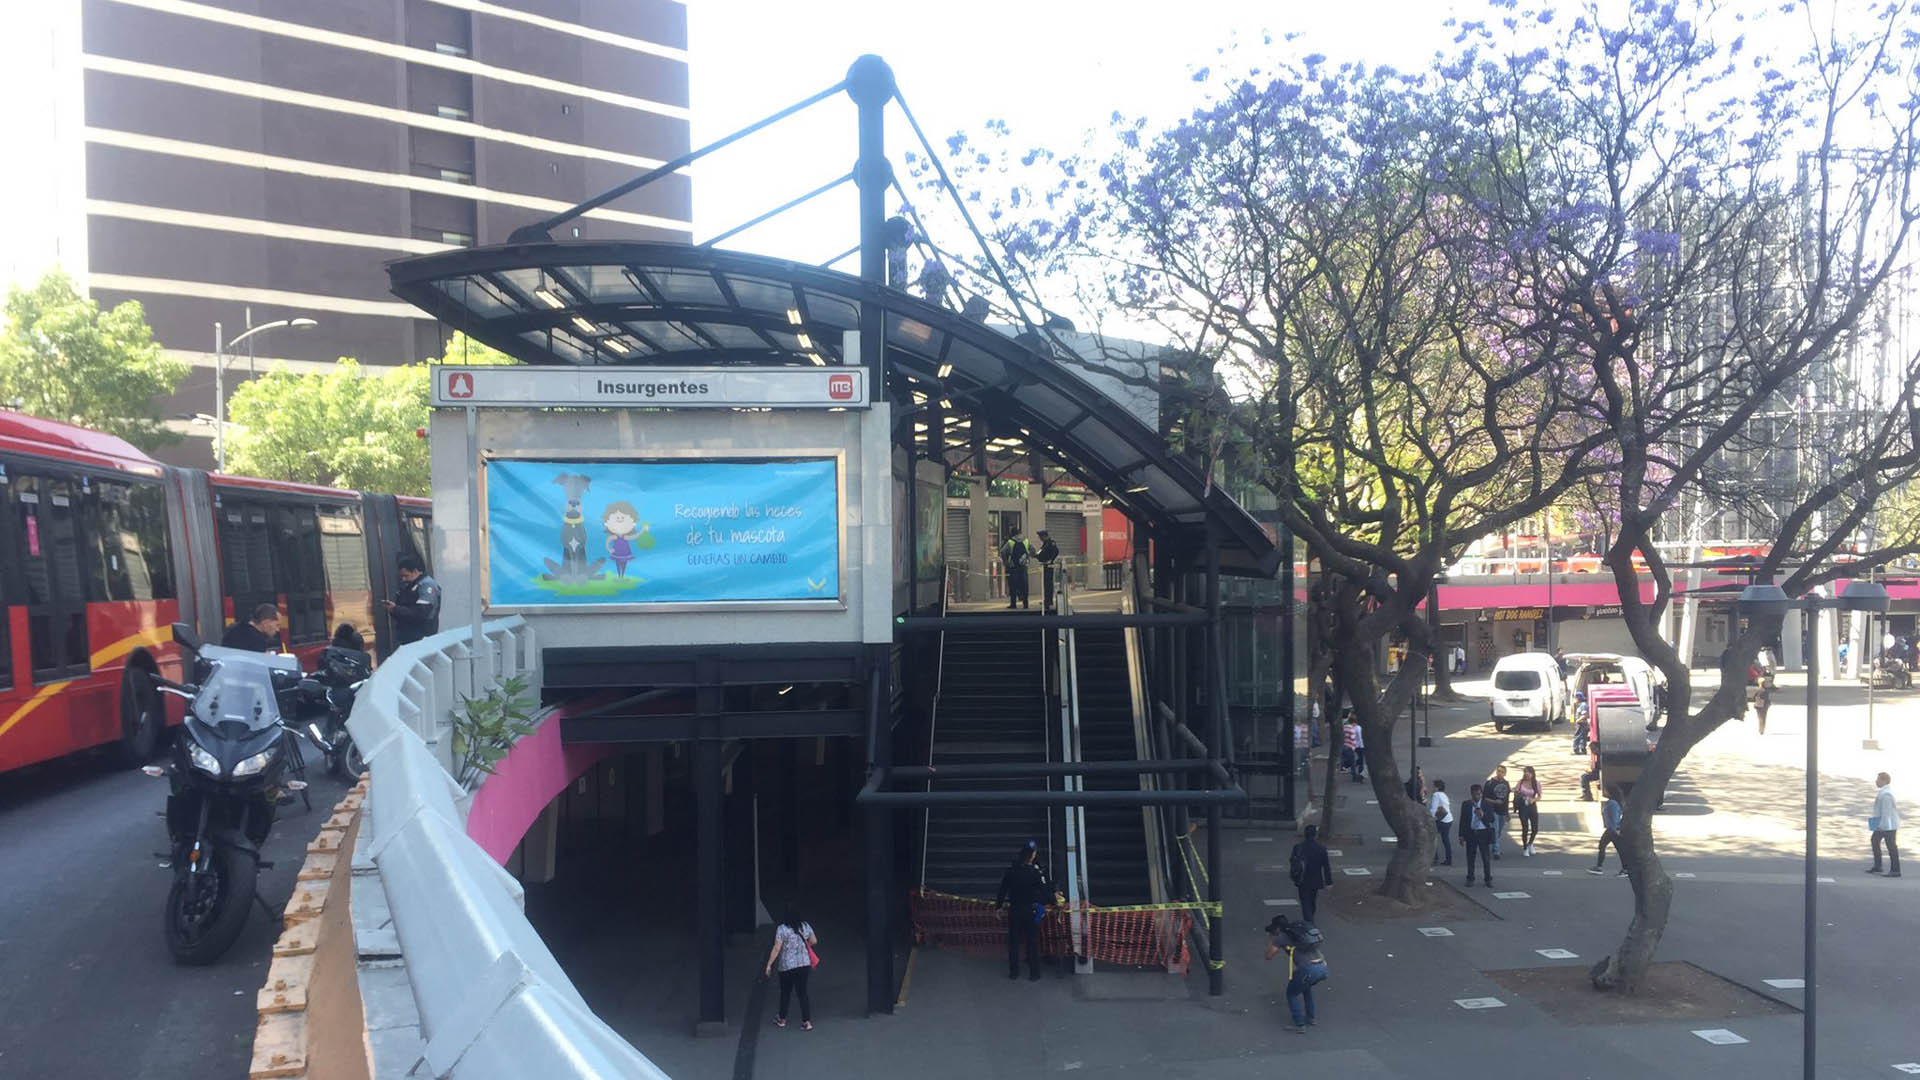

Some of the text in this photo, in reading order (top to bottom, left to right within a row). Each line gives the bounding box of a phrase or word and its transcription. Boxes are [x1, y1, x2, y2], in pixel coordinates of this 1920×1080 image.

[597, 380, 709, 397] Insurgentes
[674, 501, 802, 525] Recogiendo las heces
[686, 524, 785, 545] de tu mascota
[687, 552, 788, 566] GENERAS UN CAMBIO
[1494, 610, 1506, 620] HOT
[1506, 610, 1518, 620] DOG
